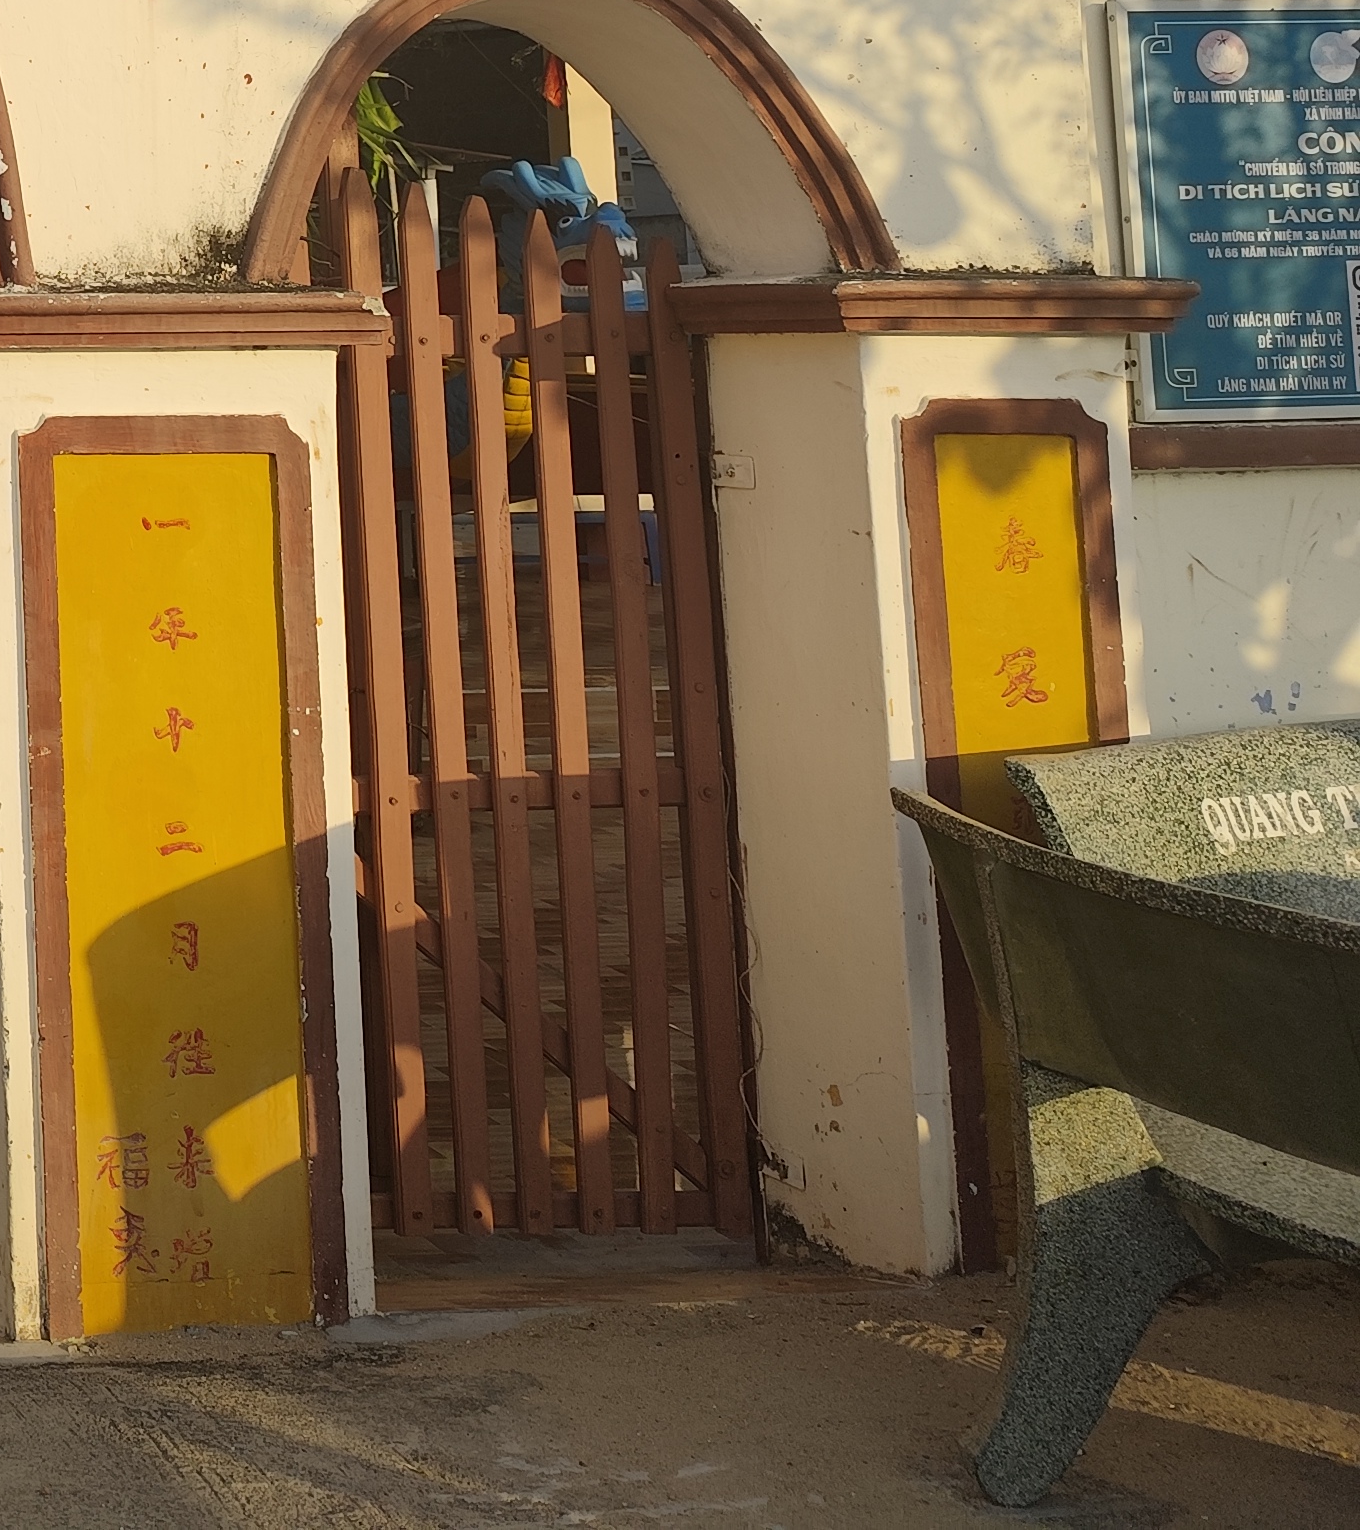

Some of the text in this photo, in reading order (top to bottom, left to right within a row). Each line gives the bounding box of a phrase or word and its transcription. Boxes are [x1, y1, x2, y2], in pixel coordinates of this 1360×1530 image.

[1188, 90, 1209, 104] BAN
[1238, 87, 1260, 106] VIỆT
[1261, 89, 1285, 103] NAM
[1292, 86, 1310, 105] HỘI
[1311, 86, 1333, 102] LIÊN
[1334, 85, 1358, 105] HIỆP
[1304, 105, 1319, 121] XÃ
[1319, 105, 1343, 120] VĨNH
[1309, 157, 1325, 175] SỐ
[1326, 161, 1360, 175] TRONG
[1179, 179, 1360, 201] DI TÍCH LỊCH SỬ
[1268, 206, 1335, 224] LĂNG
[1189, 229, 1219, 244] CHÀO
[1221, 229, 1255, 243] MỪNG
[1274, 228, 1304, 244] NIỆM
[1305, 230, 1320, 241] 36
[1321, 227, 1348, 241] NĂM
[1207, 245, 1223, 259] VÀ
[1224, 247, 1239, 259] 66
[1240, 244, 1268, 258] NĂM
[1269, 243, 1299, 258] NGÀY
[1207, 309, 1343, 329] QUÝ KHÁCH QUÉT MÃ QR
[1257, 328, 1344, 349] ĐỂ TÌM HIỂU VỀ
[1256, 352, 1346, 372] DI TÍCH LỊCH SỬ
[1217, 373, 1348, 393] LĂNG NAM HẢI VĨNH HY
[1201, 788, 1325, 856] QUANG
